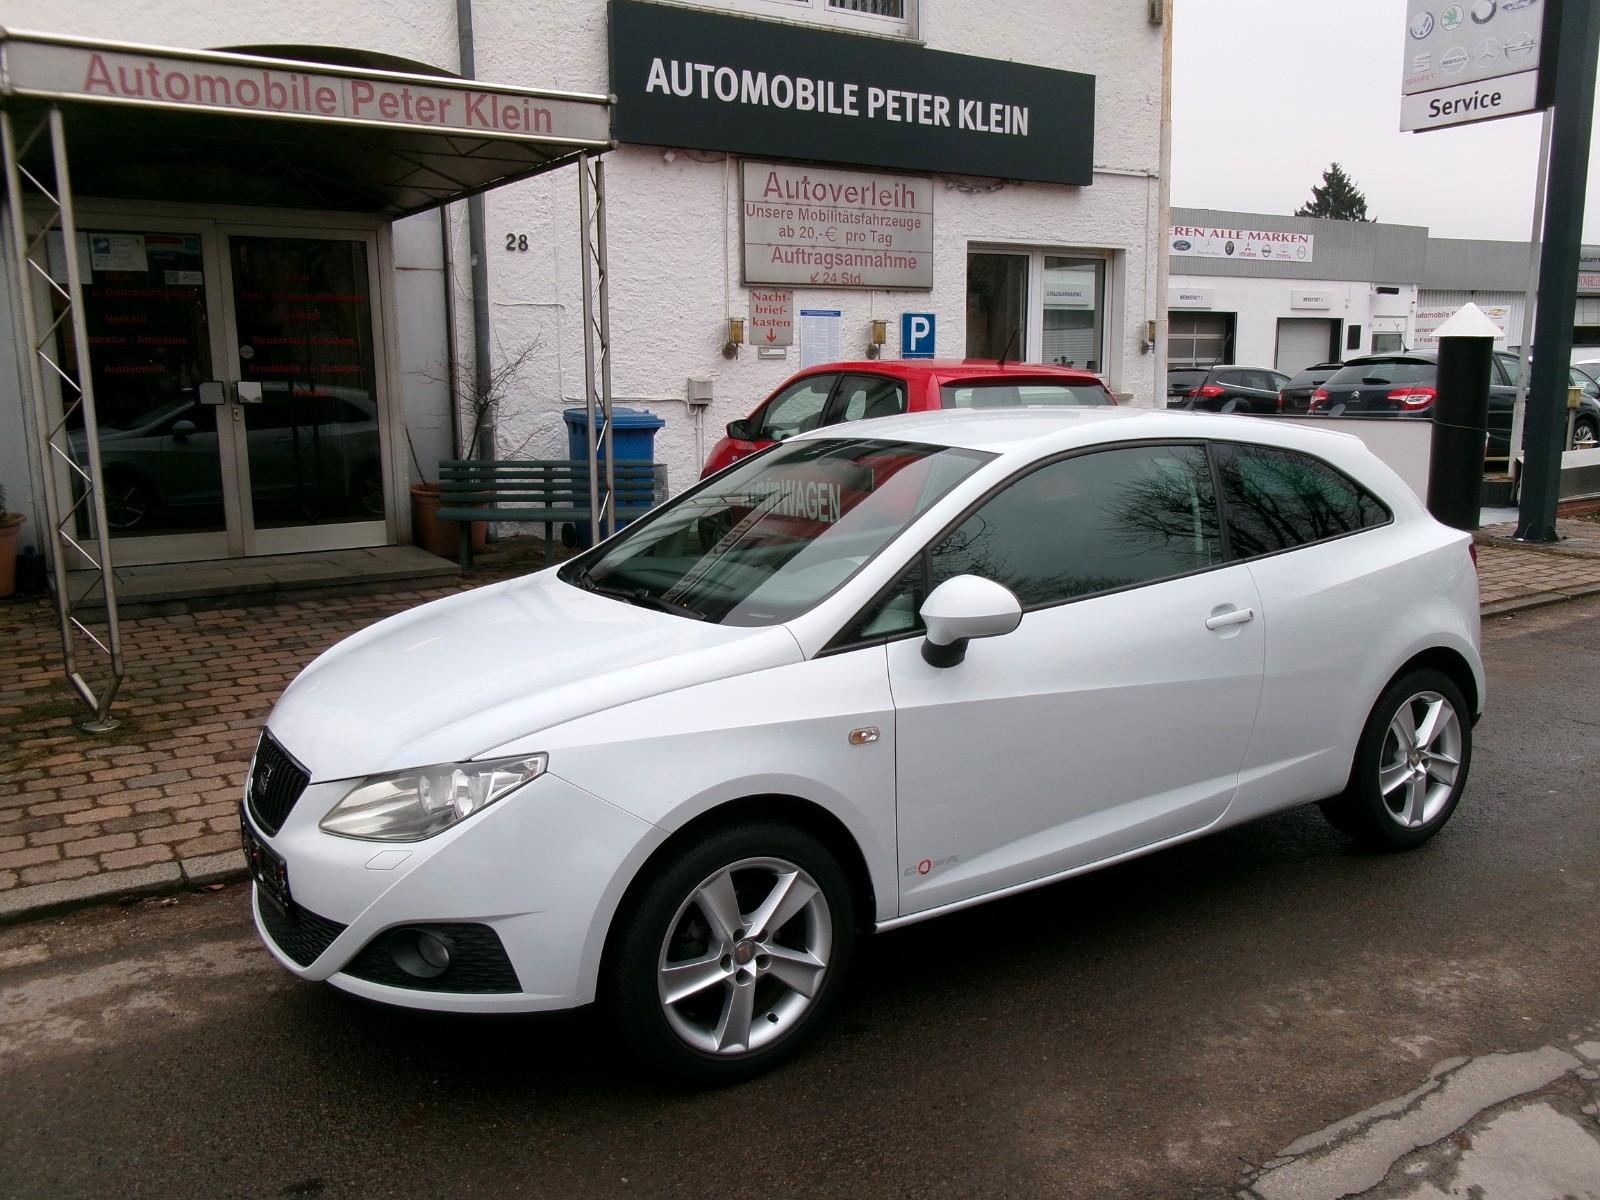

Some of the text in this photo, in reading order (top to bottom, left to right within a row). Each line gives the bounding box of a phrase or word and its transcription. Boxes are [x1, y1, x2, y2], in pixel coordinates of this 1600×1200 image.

[84, 53, 553, 134] Automobile Peter Klein
[646, 58, 1029, 136] AUTOMOBILE PETER KLEIN
[1428, 90, 1502, 118] Service
[763, 172, 915, 209] Autoverleih
[746, 204, 921, 231] Unsere Mobilitätsfahrzeuge
[506, 234, 528, 251] 28
[779, 225, 795, 238] ab
[846, 231, 866, 245] pro
[870, 231, 892, 246] Tag
[1210, 230, 1244, 240] ALLE
[1248, 232, 1309, 243] MARKEN
[771, 247, 917, 269] Auftragsannahme
[823, 273, 837, 283] 24
[752, 292, 790, 302] Nacht-
[755, 305, 787, 315] brief-
[752, 317, 790, 327] kasten
[911, 317, 930, 351] P
